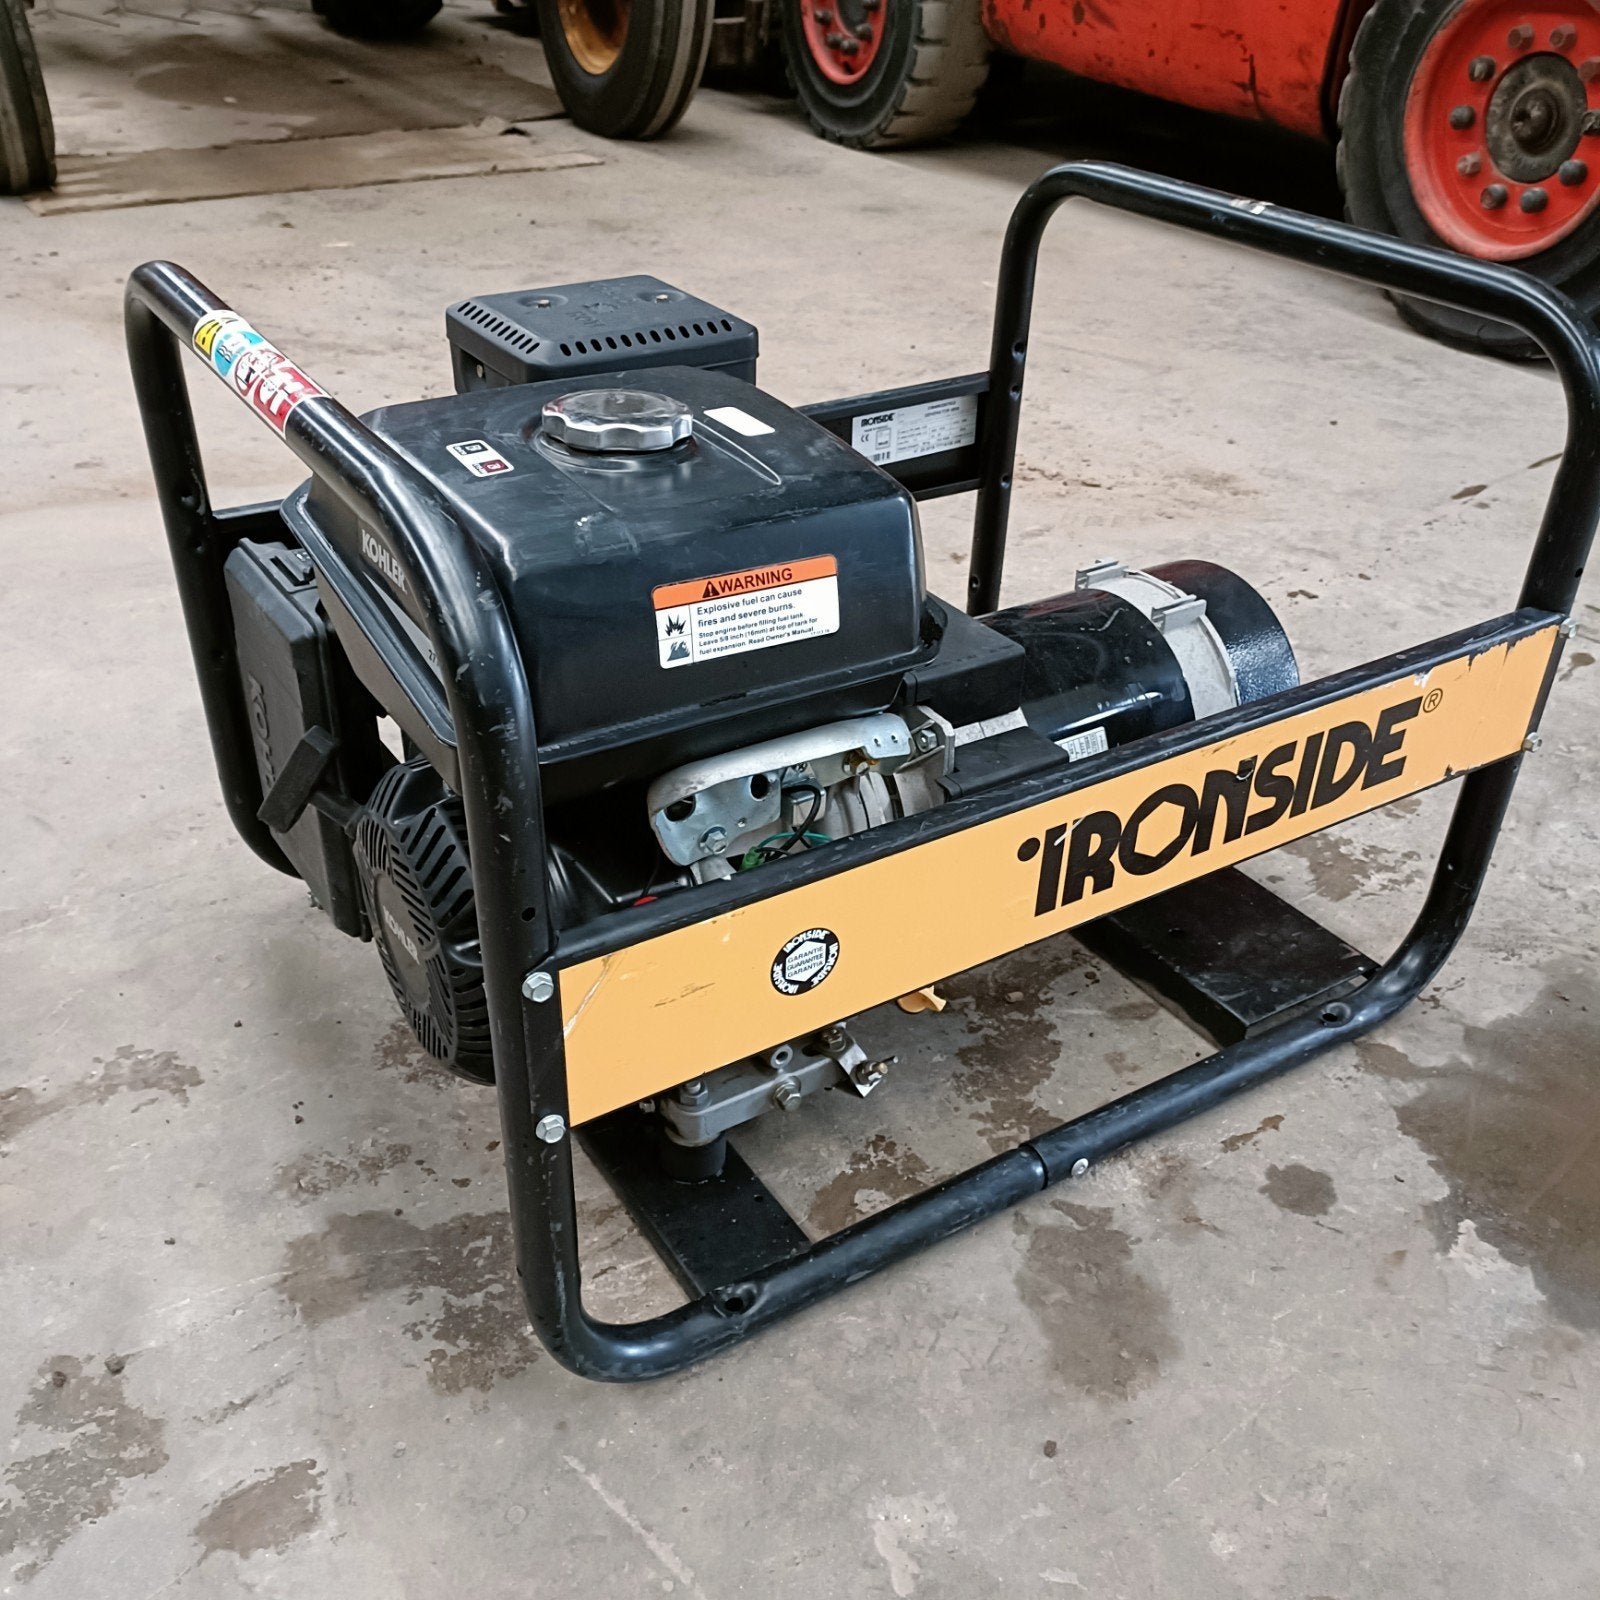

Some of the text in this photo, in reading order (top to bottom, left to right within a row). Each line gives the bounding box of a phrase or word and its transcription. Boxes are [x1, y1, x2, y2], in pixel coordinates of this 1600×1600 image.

[361, 529, 407, 594] KOHLER
[719, 568, 792, 593] WARNING
[697, 589, 802, 615] Explosive fuel can cause
[698, 603, 795, 627] fires and severe burns.
[699, 631, 714, 639] Stop
[738, 622, 758, 630] before
[699, 639, 718, 647] Leave
[745, 628, 768, 638] (16mm)
[776, 624, 786, 632] top
[795, 619, 807, 627] tank
[749, 637, 765, 645] Read
[766, 631, 791, 641] Owner's
[783, 929, 831, 953] IRONSIDE
[787, 945, 823, 964] GARANTIE
[787, 952, 824, 971] GUARANTEE
[811, 942, 838, 988] IRONSIDE
[772, 962, 799, 994] IRONSIDE
[787, 961, 823, 978] GARANTIA
